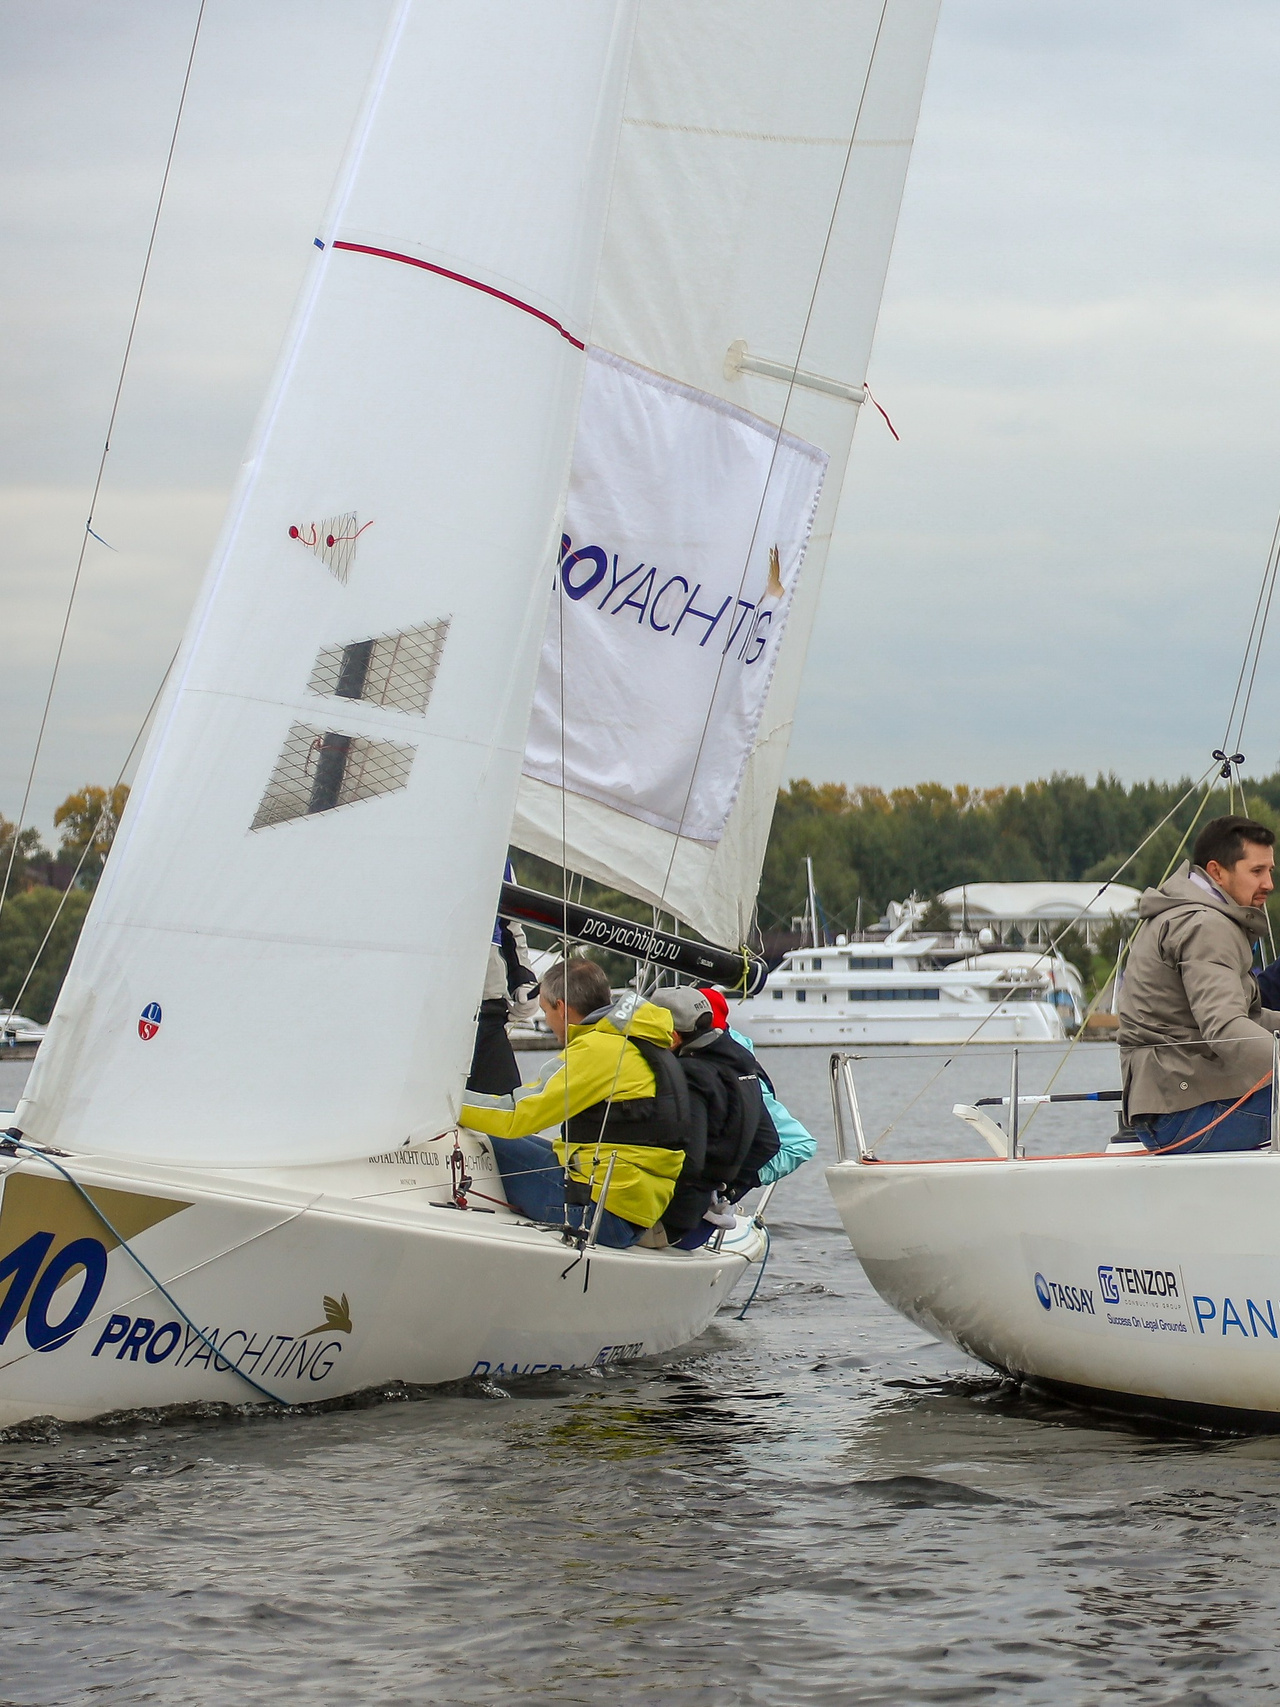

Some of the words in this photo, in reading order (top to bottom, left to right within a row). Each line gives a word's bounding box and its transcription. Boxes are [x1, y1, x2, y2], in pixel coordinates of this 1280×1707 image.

[578, 917, 681, 961] pro-yachting.ru
[394, 1150, 419, 1165] YACHT
[420, 1151, 440, 1166] CLUB
[0, 1231, 108, 1353] 10
[1049, 1282, 1096, 1315] TASSAY
[1115, 1267, 1179, 1298] TENZOR
[1107, 1313, 1132, 1327] Success
[1132, 1316, 1142, 1328] On
[1141, 1317, 1160, 1332] Legal
[1160, 1319, 1188, 1333] Grounds
[91, 1314, 342, 1381] PROYACHTING
